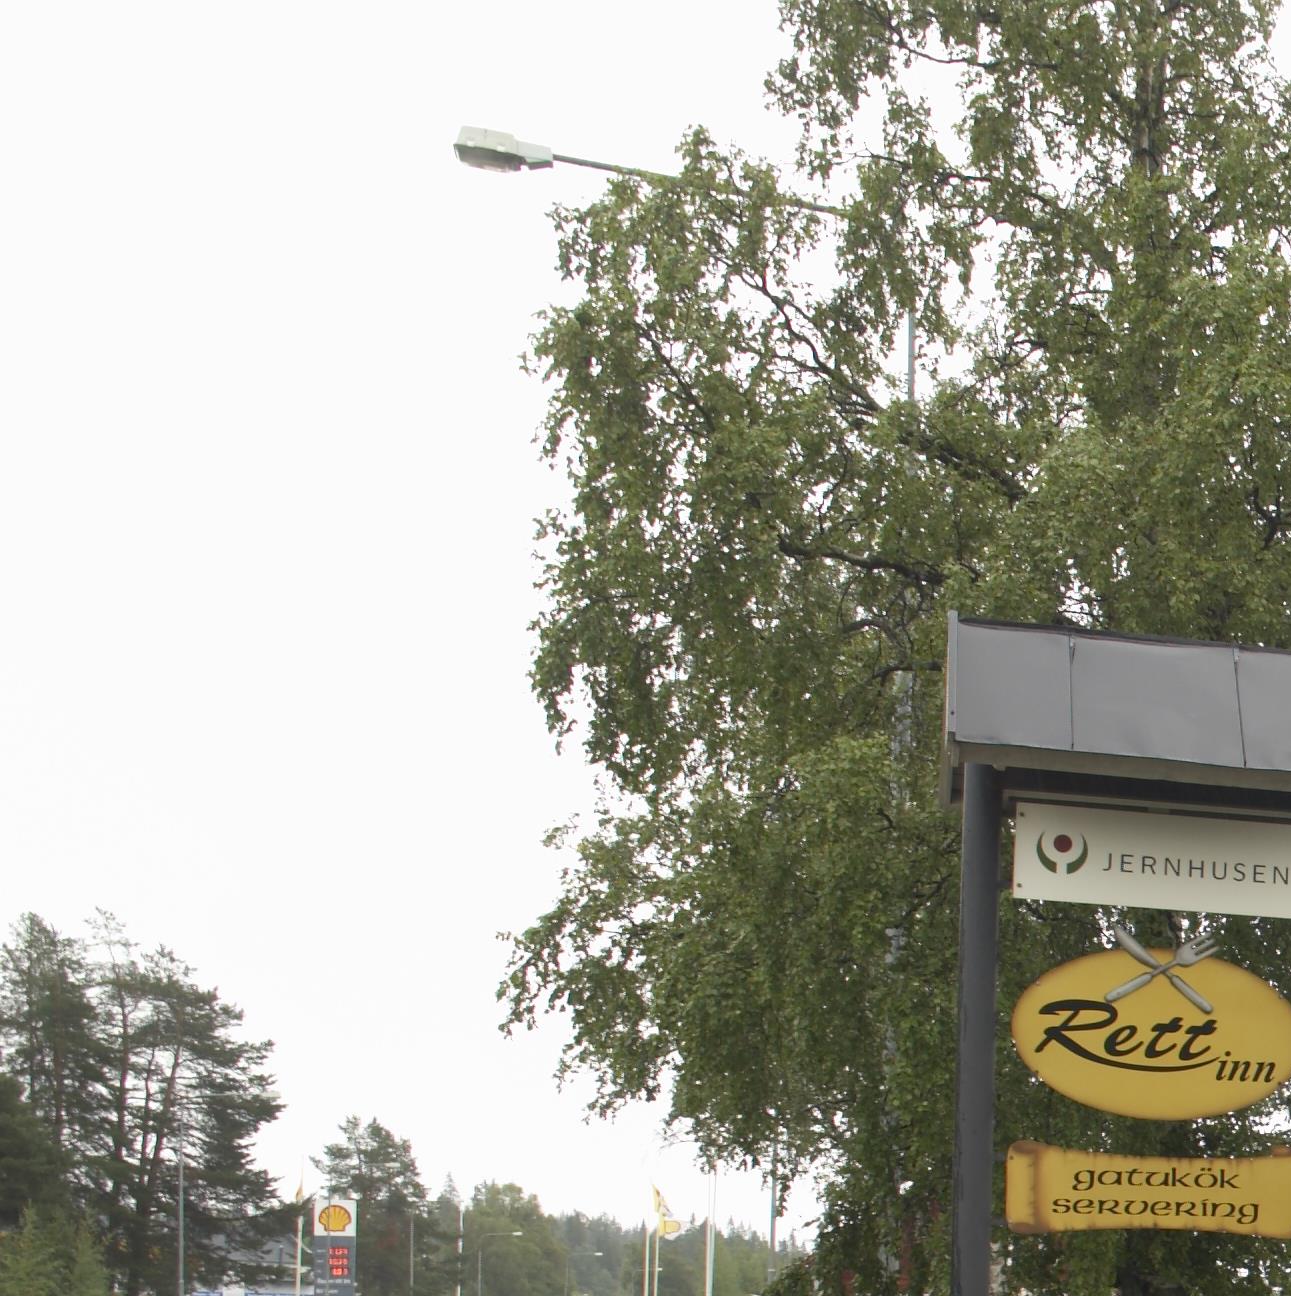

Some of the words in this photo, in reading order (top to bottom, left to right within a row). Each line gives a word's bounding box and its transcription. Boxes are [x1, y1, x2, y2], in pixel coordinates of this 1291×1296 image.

[1103, 853, 1290, 885] JERNHUSEN
[1034, 999, 1221, 1073] Rett
[1215, 1052, 1276, 1083] inn
[1072, 1166, 1240, 1191] gatukök
[1051, 1198, 1259, 1225] servering
